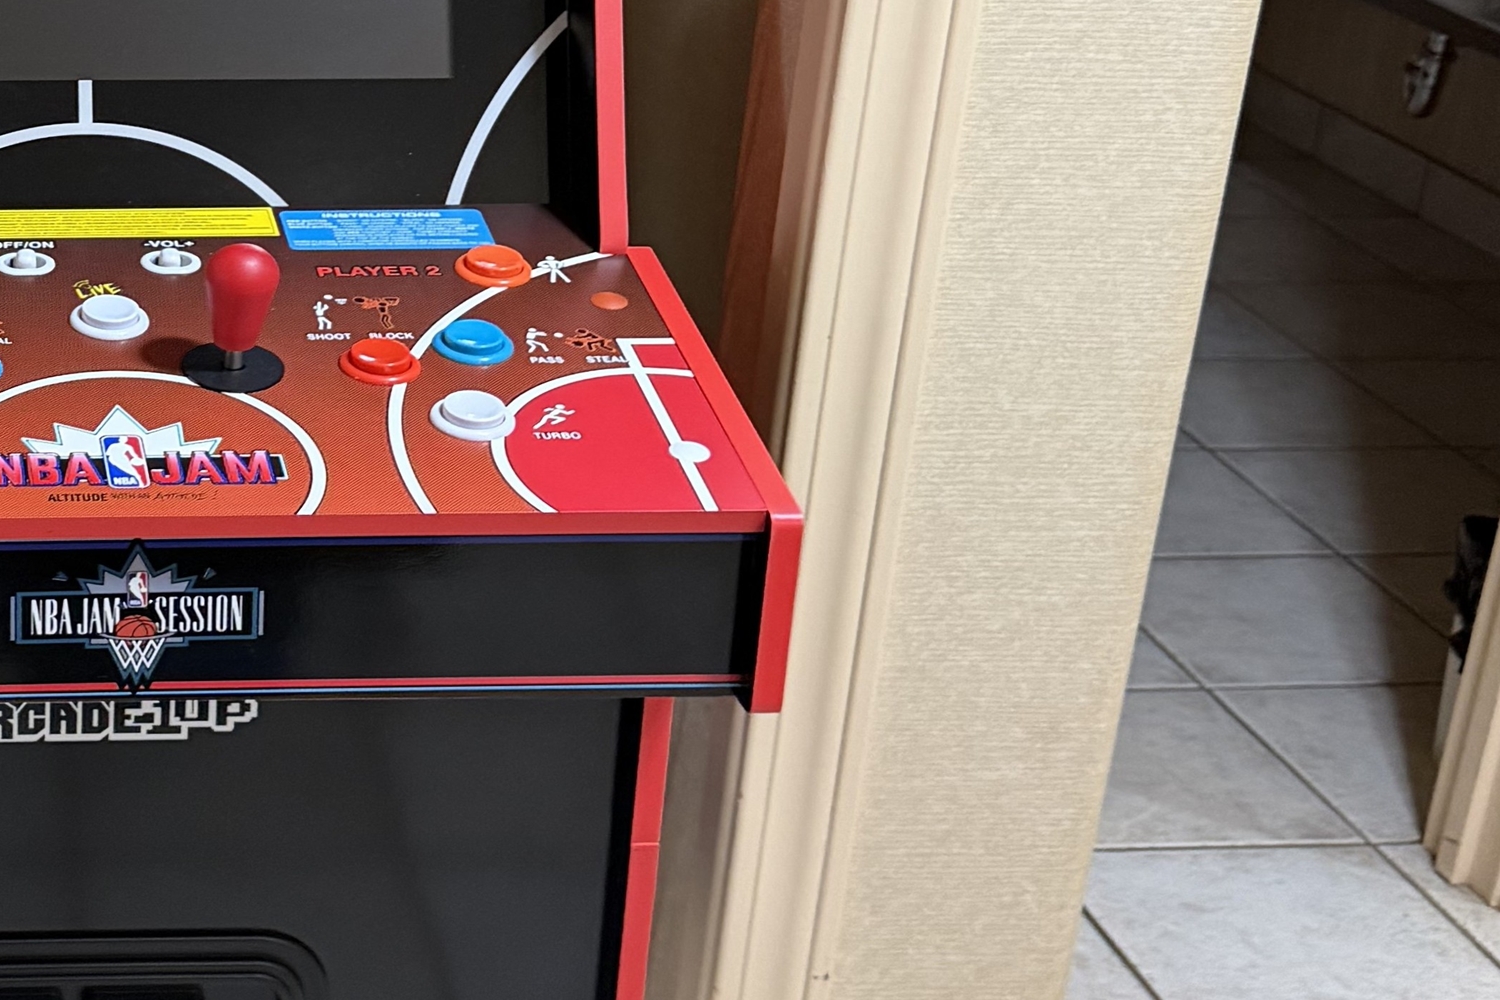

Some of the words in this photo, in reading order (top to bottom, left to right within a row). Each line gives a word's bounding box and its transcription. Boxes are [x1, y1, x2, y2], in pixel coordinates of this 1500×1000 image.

[320, 211, 442, 219] INSTRUCTIONS
[315, 265, 419, 277] PLAYER
[425, 265, 443, 276] 2
[306, 332, 352, 341] SHOOT
[368, 332, 415, 340] BLOCK
[529, 355, 565, 364] PASS
[585, 355, 629, 364] STEAL
[532, 431, 582, 440] TURBO
[149, 449, 279, 486] JAM
[47, 493, 109, 503] ALTITUDE
[30, 598, 74, 635] NBA
[76, 597, 120, 635] JAM
[155, 594, 244, 633] SESSION
